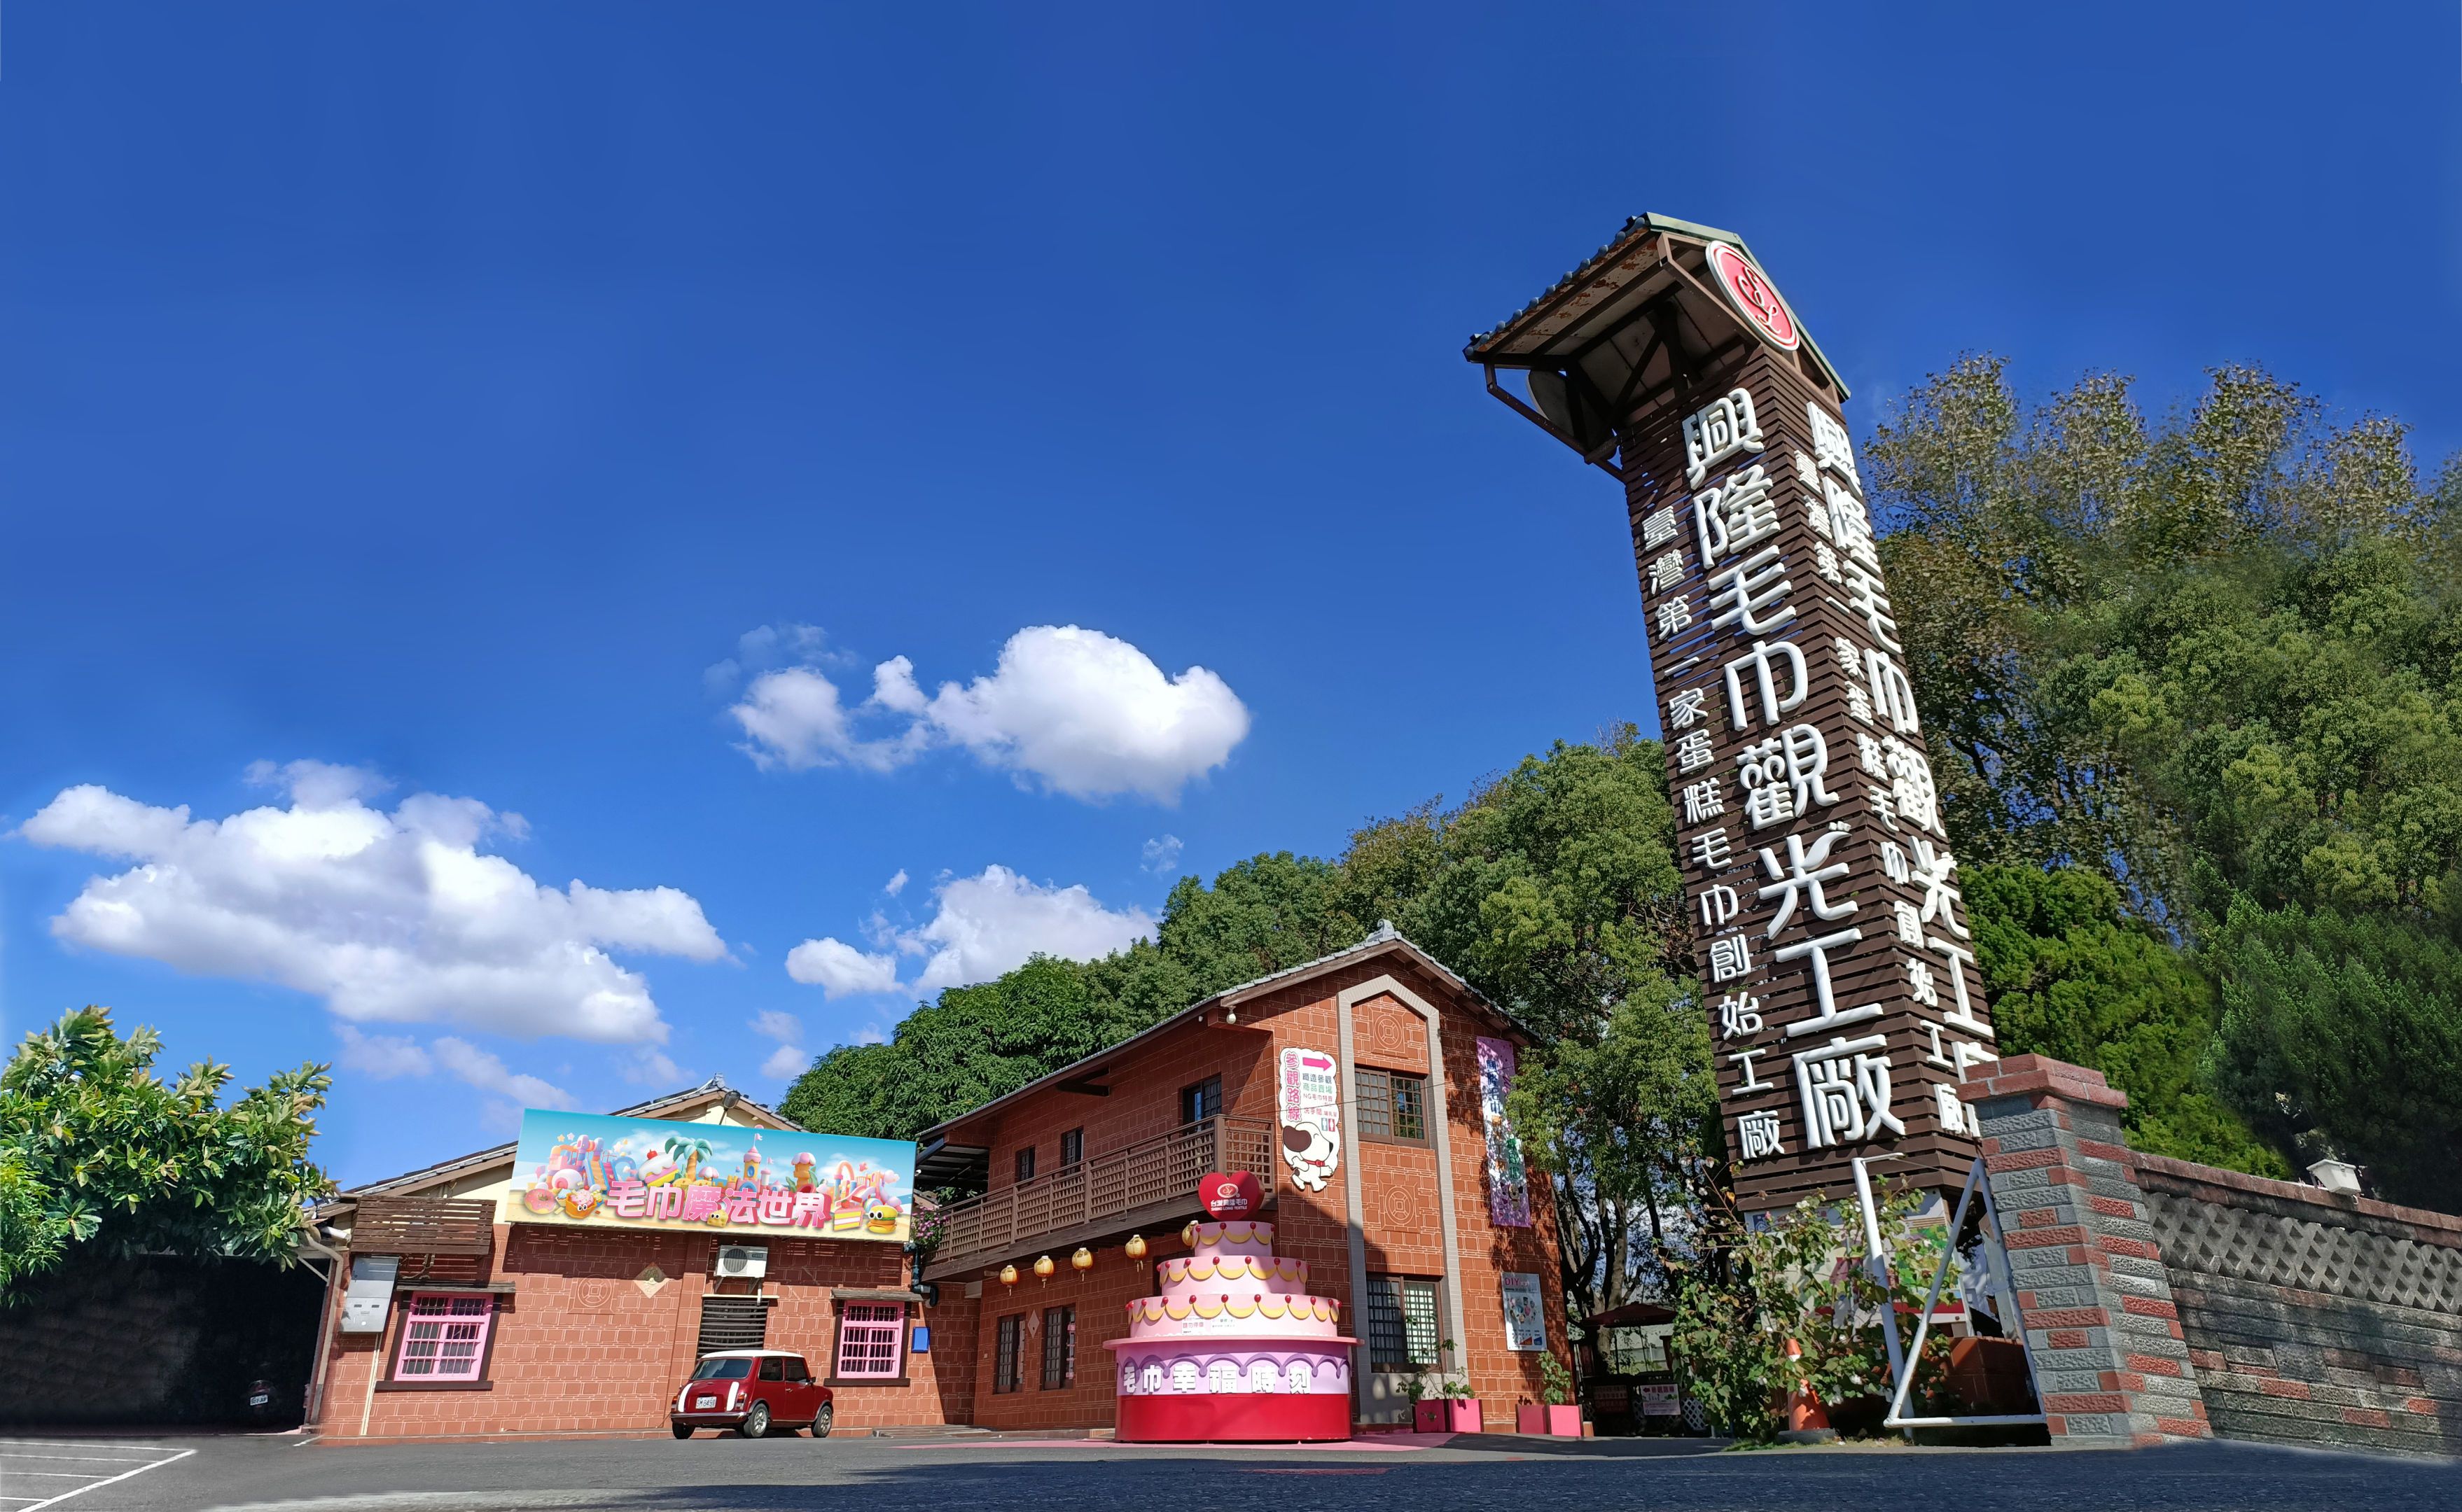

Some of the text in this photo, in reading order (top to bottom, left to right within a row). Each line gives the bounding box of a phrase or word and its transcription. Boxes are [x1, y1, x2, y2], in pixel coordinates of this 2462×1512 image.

[1683, 388, 1906, 1149] 興隆毛巾觀光工廠
[1642, 505, 1785, 1160] 臺灣第一家蛋糕毛巾創始工廠
[1285, 1051, 1301, 1121] 參觀路線
[606, 1180, 831, 1228] 毛巾魔法世界
[1123, 1364, 1311, 1394] 毛巾幸福時刻
